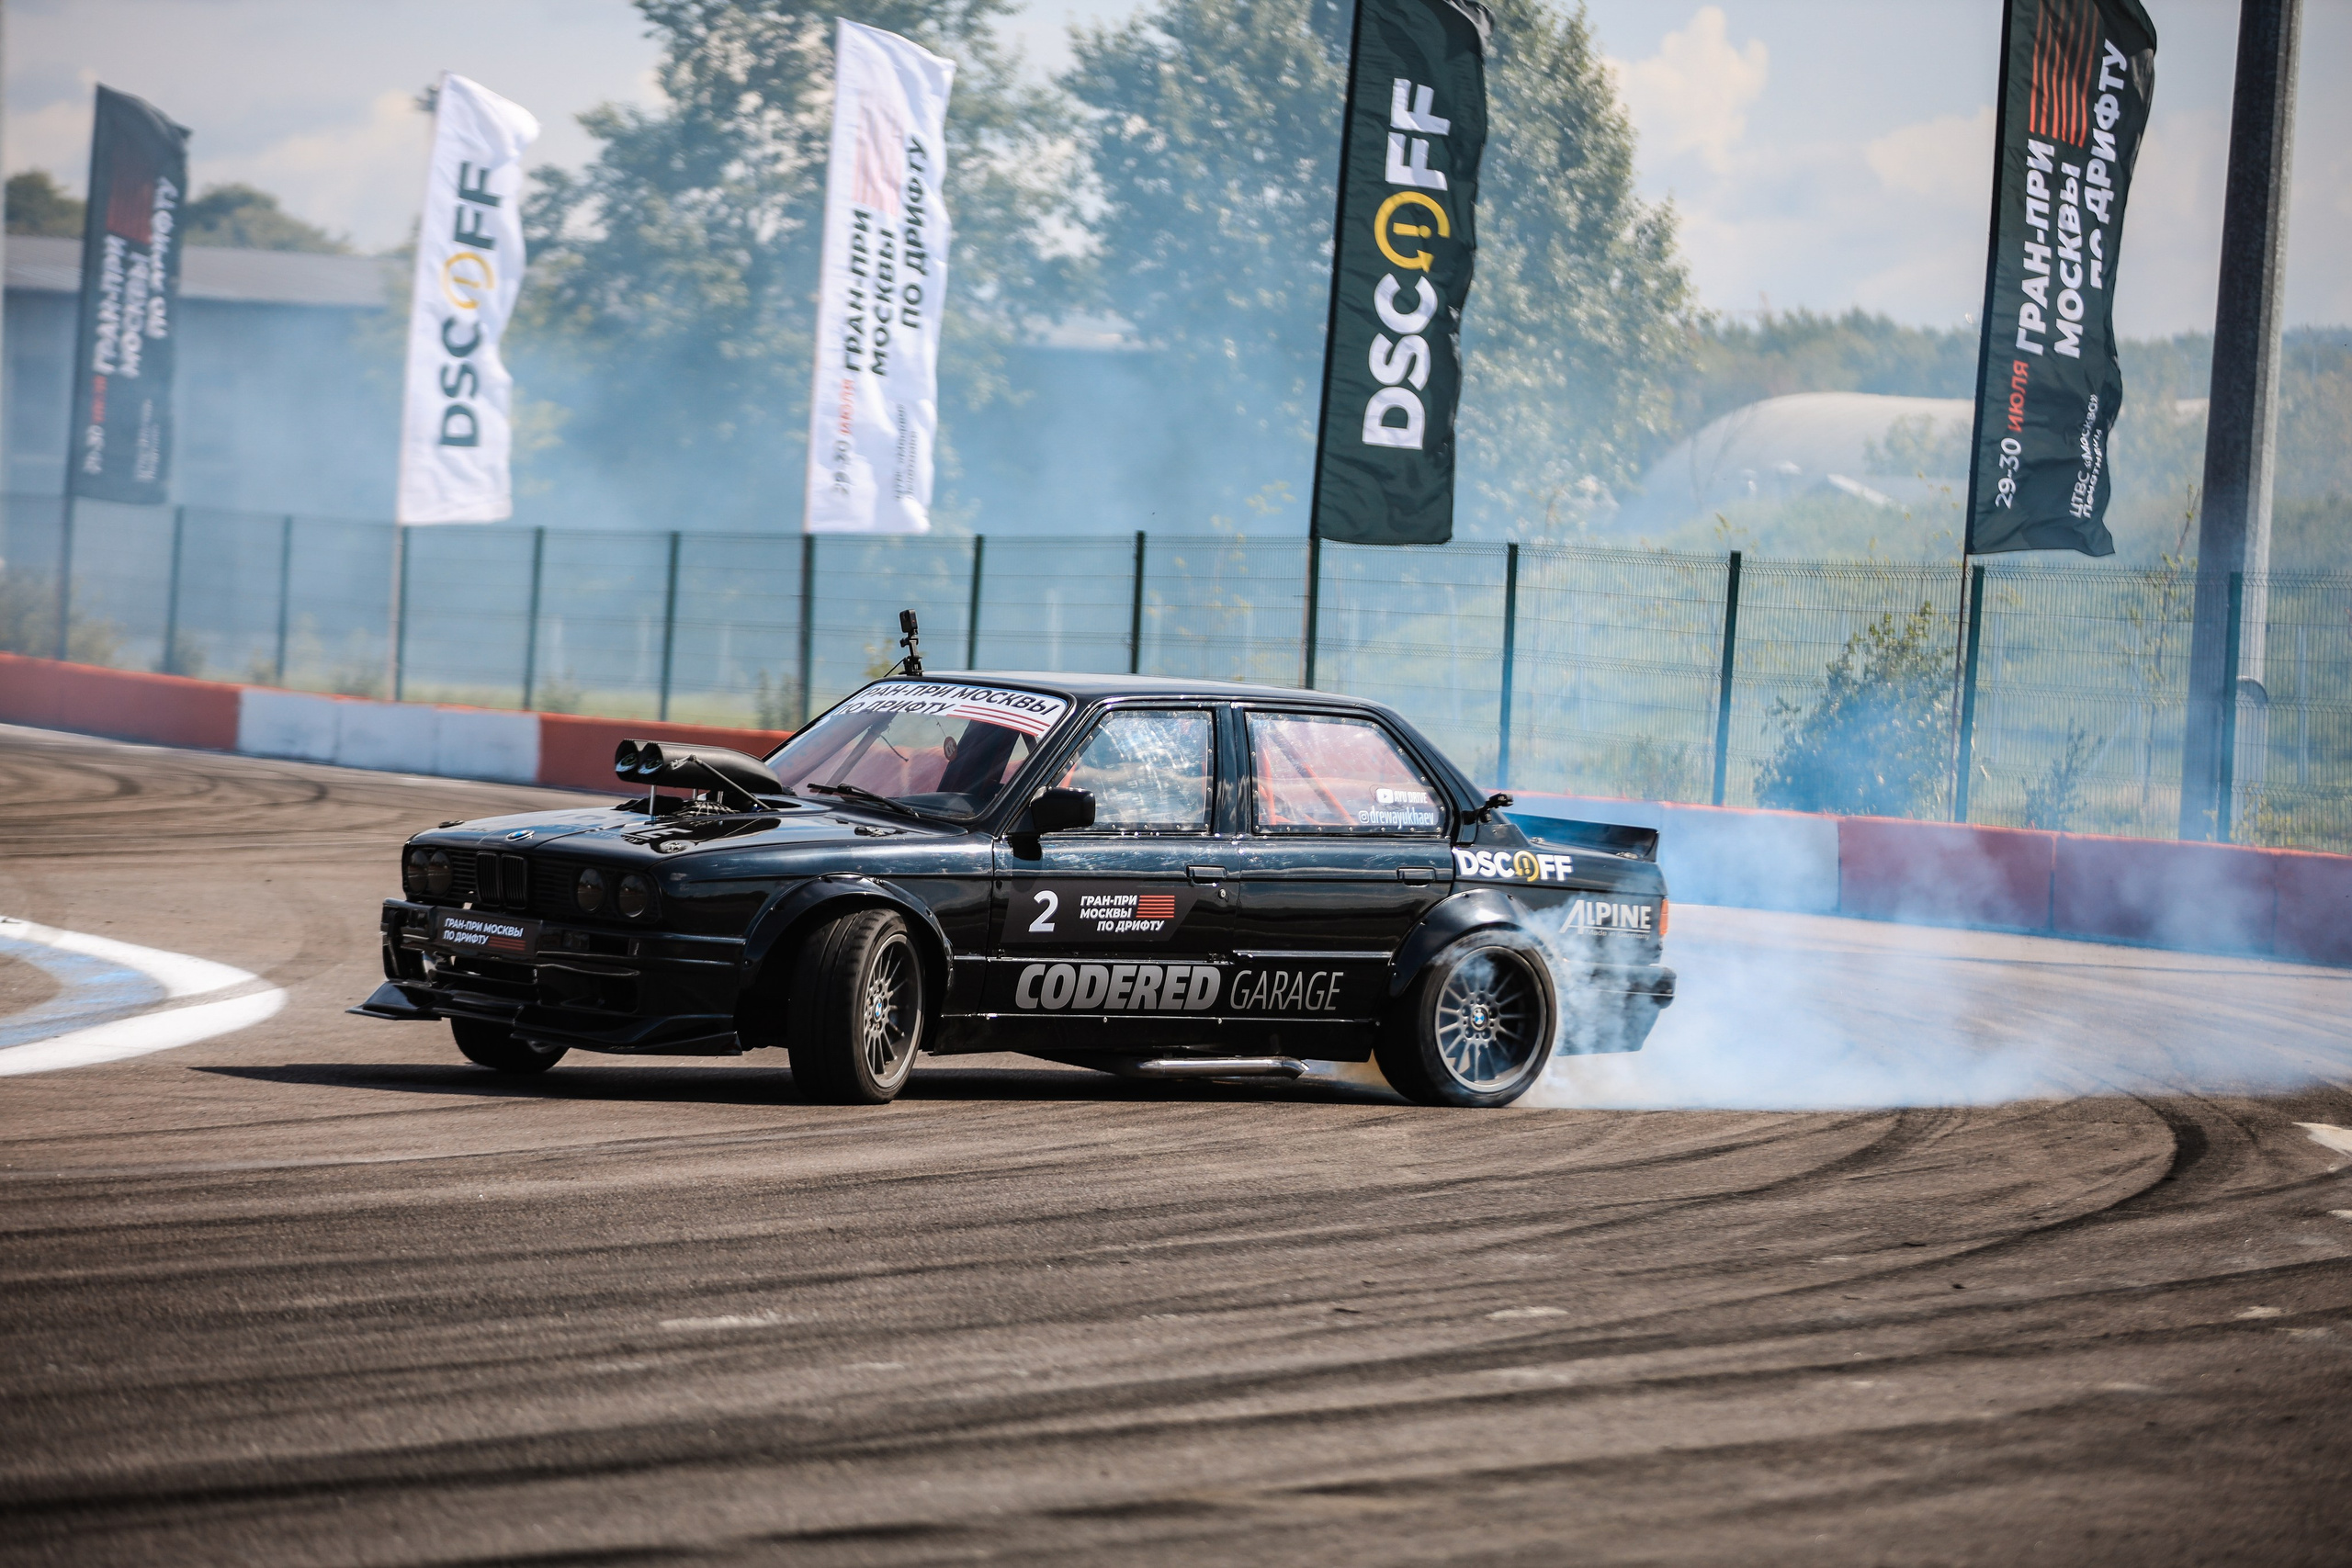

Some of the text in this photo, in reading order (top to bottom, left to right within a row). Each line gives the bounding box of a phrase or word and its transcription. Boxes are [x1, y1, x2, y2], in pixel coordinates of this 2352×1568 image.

[2084, 39, 2128, 224] ДРИФТУ
[899, 135, 928, 329] ПО ДРИФТУ
[2015, 138, 2055, 355] ГРАН-ПРИ
[2053, 162, 2084, 359] МОСКВЫ
[844, 209, 872, 372] ГРАН-ПРИ
[871, 228, 896, 377] МОСКВЫ
[1995, 359, 2029, 509] 29-30 ИЮЛЯ
[2069, 470, 2088, 518] ЦТВС
[950, 687, 1060, 715] МОСКВЫ
[1408, 792, 1428, 804] DRIVE
[1028, 890, 1058, 932] 2
[1080, 895, 1137, 908] ГРАН-ПРИ
[1080, 908, 1132, 919] МОСКВЫ
[1559, 899, 1652, 934] ALPINE
[443, 930, 489, 944] ПО ДРИФТУ
[444, 918, 524, 937] ГРАН-ПРИ МОСКВЫ
[1097, 920, 1165, 933] ПО ДРИФТУ
[1618, 931, 1650, 941] Germany
[1015, 964, 1344, 1010] CODERED GARAGE
